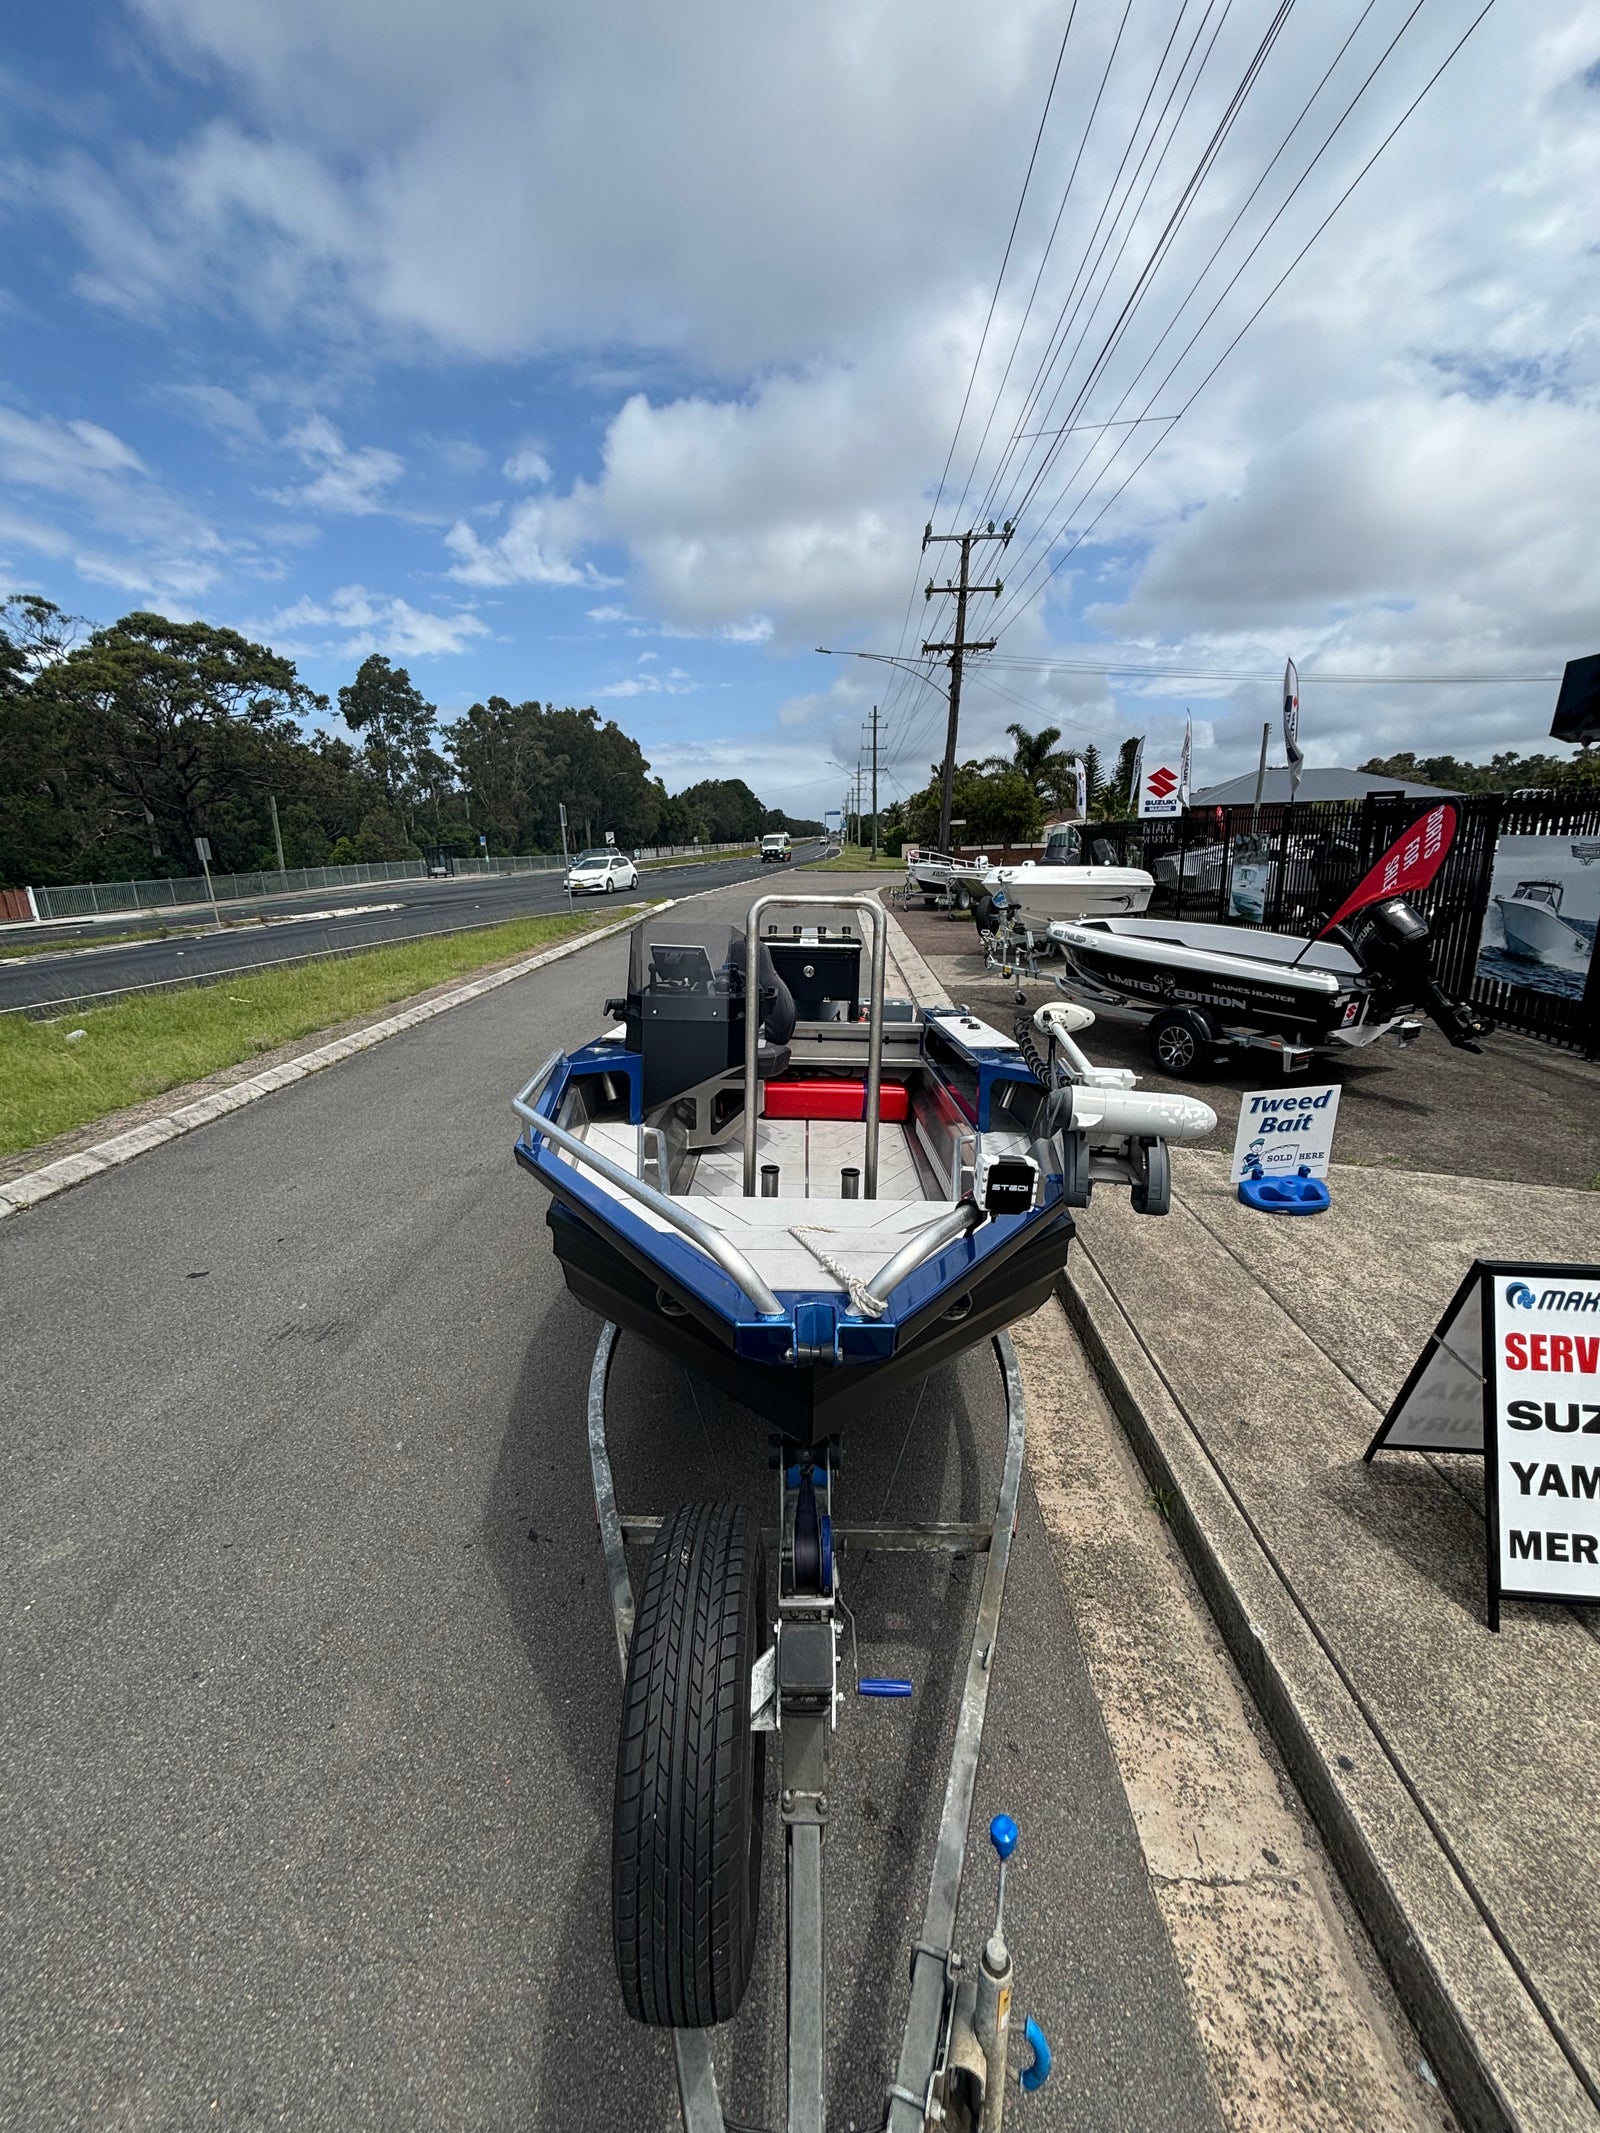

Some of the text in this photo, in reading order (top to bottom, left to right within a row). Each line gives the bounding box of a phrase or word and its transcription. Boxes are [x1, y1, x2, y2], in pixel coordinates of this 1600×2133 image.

[1420, 804, 1446, 860] BOATS
[1402, 836, 1421, 871] FOR
[1107, 972, 1247, 1010] LIMITED EDITION
[1212, 981, 1296, 1004] HAINES HUNTER
[1249, 1089, 1334, 1114] Tweed
[1258, 1113, 1315, 1134] Bait
[1266, 1152, 1325, 1163] SOLD HERE
[991, 1183, 1029, 1193] STEDI
[1538, 1289, 1600, 1312] MAK
[1504, 1331, 1600, 1374] SERV
[1506, 1400, 1600, 1435] SUZ
[1508, 1461, 1600, 1500] YAM
[1508, 1529, 1600, 1565] MER
